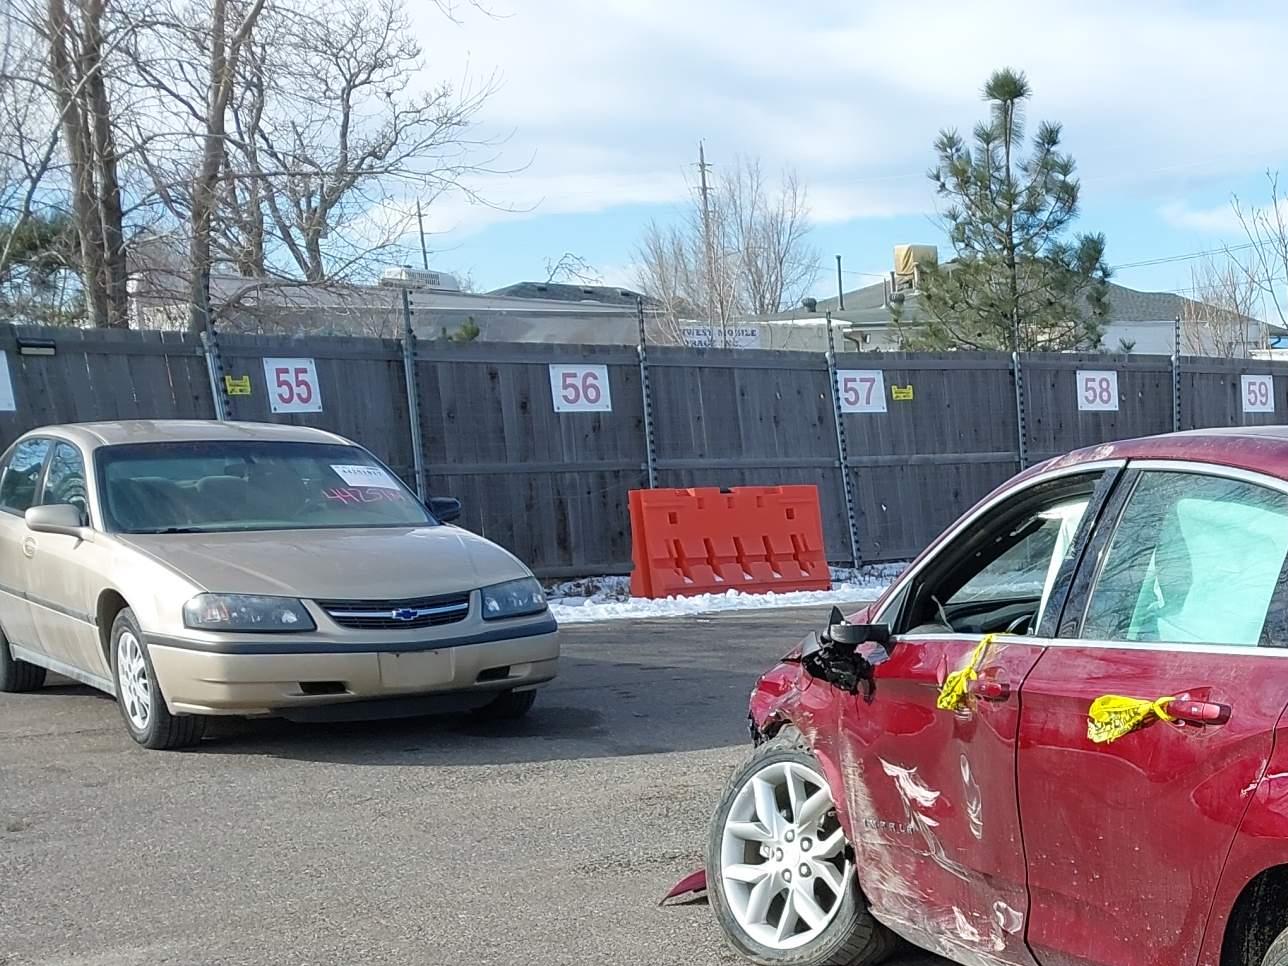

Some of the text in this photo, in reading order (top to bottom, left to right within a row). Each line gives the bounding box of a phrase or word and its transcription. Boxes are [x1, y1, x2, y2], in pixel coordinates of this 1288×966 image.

[275, 367, 312, 405] 55
[561, 371, 601, 405] 56
[843, 377, 876, 406] 57
[1084, 377, 1112, 405] 58
[1247, 381, 1269, 406] 59
